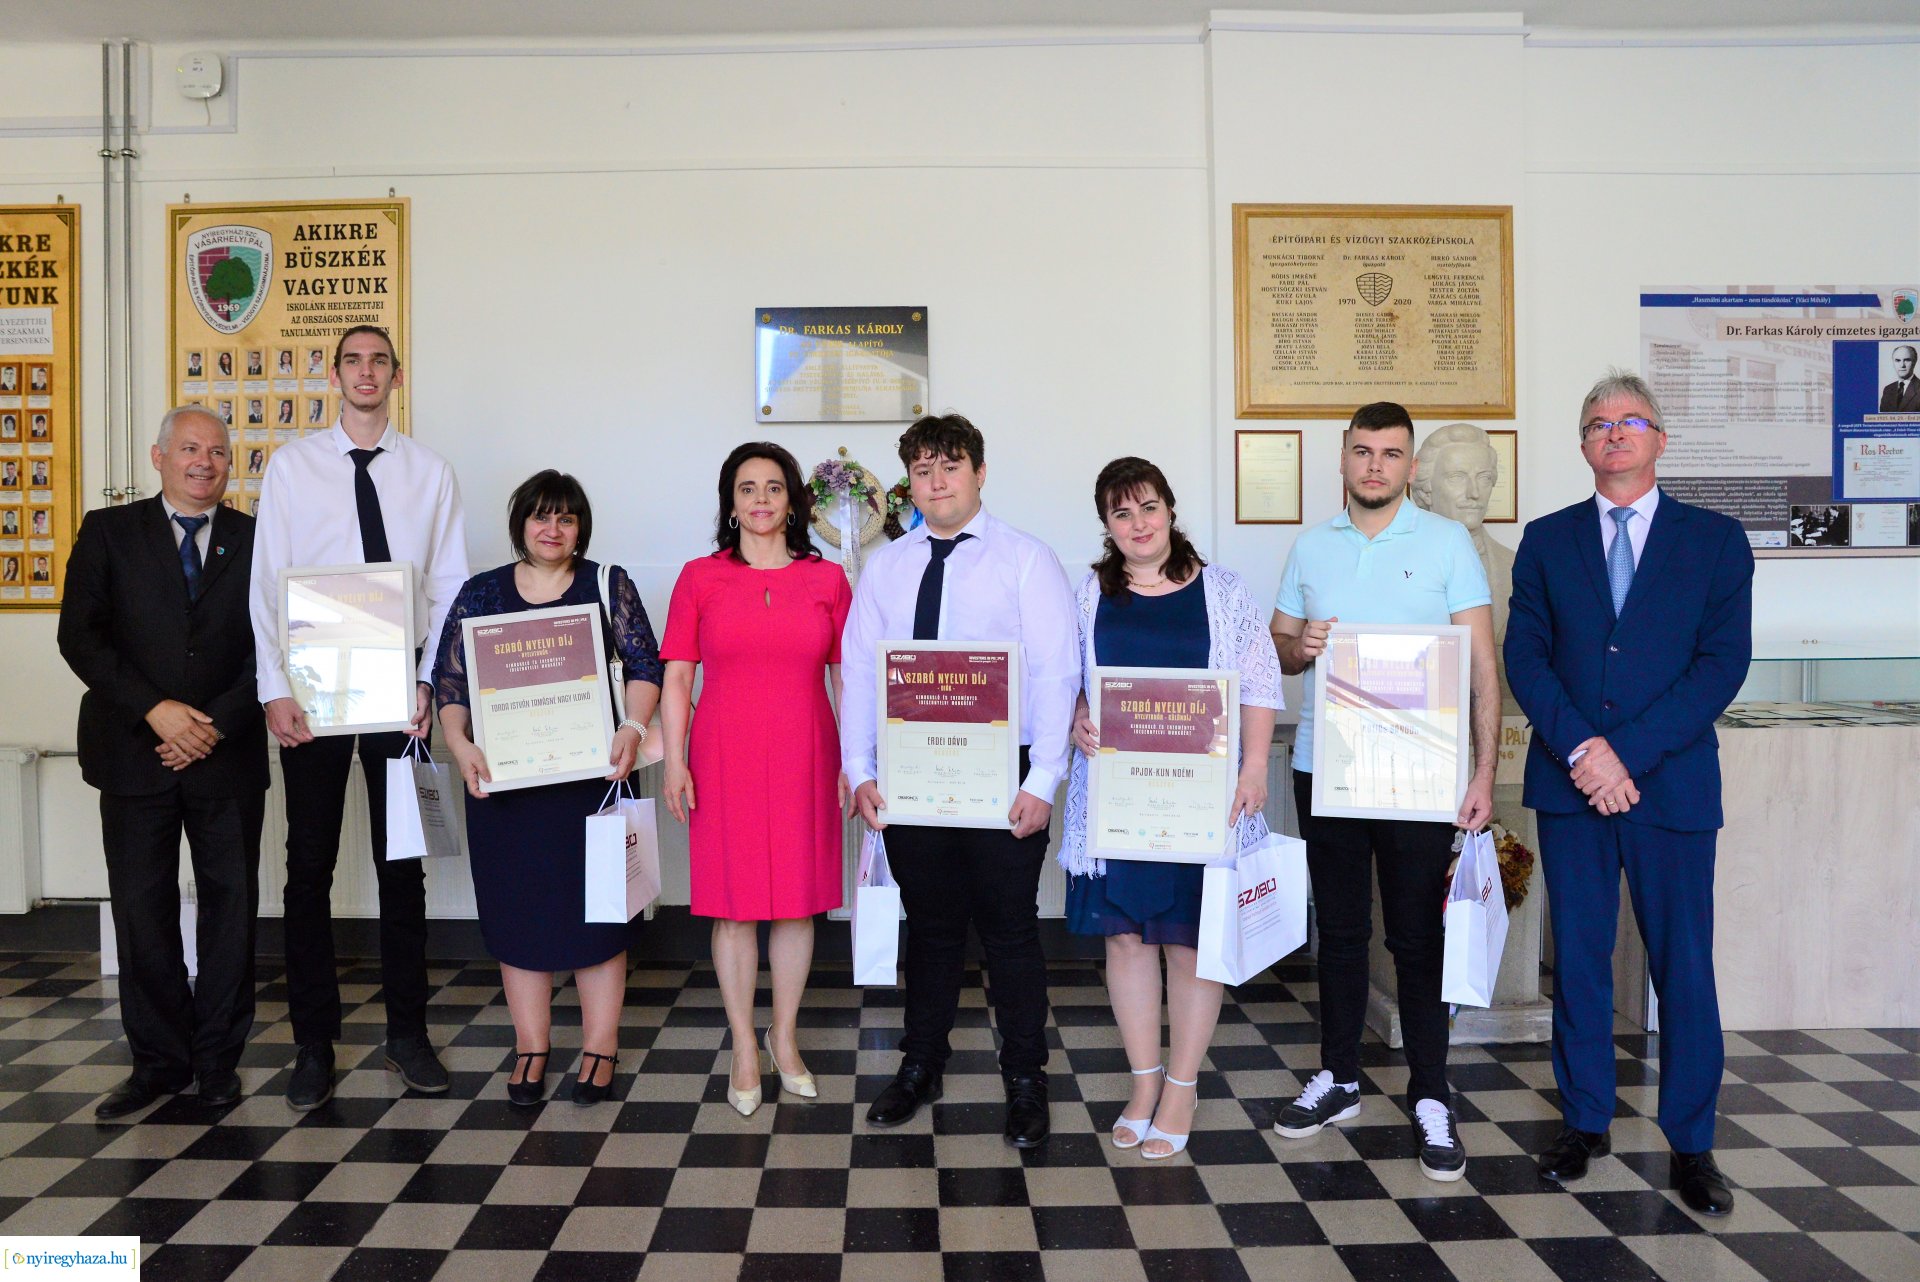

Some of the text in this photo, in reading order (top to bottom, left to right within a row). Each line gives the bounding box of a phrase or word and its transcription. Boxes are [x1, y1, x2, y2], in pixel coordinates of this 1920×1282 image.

[293, 223, 378, 241] AKIKRE
[1330, 234, 1340, 244] ÉS
[285, 244, 386, 268] BÜSZKÉK
[283, 277, 388, 296] VAGYUNK
[0, 287, 59, 305] UNK
[218, 304, 240, 312] 1969
[286, 300, 384, 312] ISKOLÁNK HELYEZETTJEI
[302, 313, 343, 324] ORSZÁGOS
[344, 314, 379, 322] SZAKMAI
[280, 326, 330, 337] TANULMÁNYI
[804, 325, 851, 335] FARKAS
[857, 322, 904, 334] KÁROLY
[1726, 325, 1920, 339] Dr. Farkas Károly címzetes igazgat
[494, 634, 573, 654] SZABÓ NYELVI DÍJ
[906, 670, 987, 685] SZABÓ NYELVI DÍJ
[1121, 699, 1206, 714] SZABÓ NYELVI DÍJ
[1505, 726, 1527, 745] PÁL
[1238, 878, 1277, 908] SZABO
